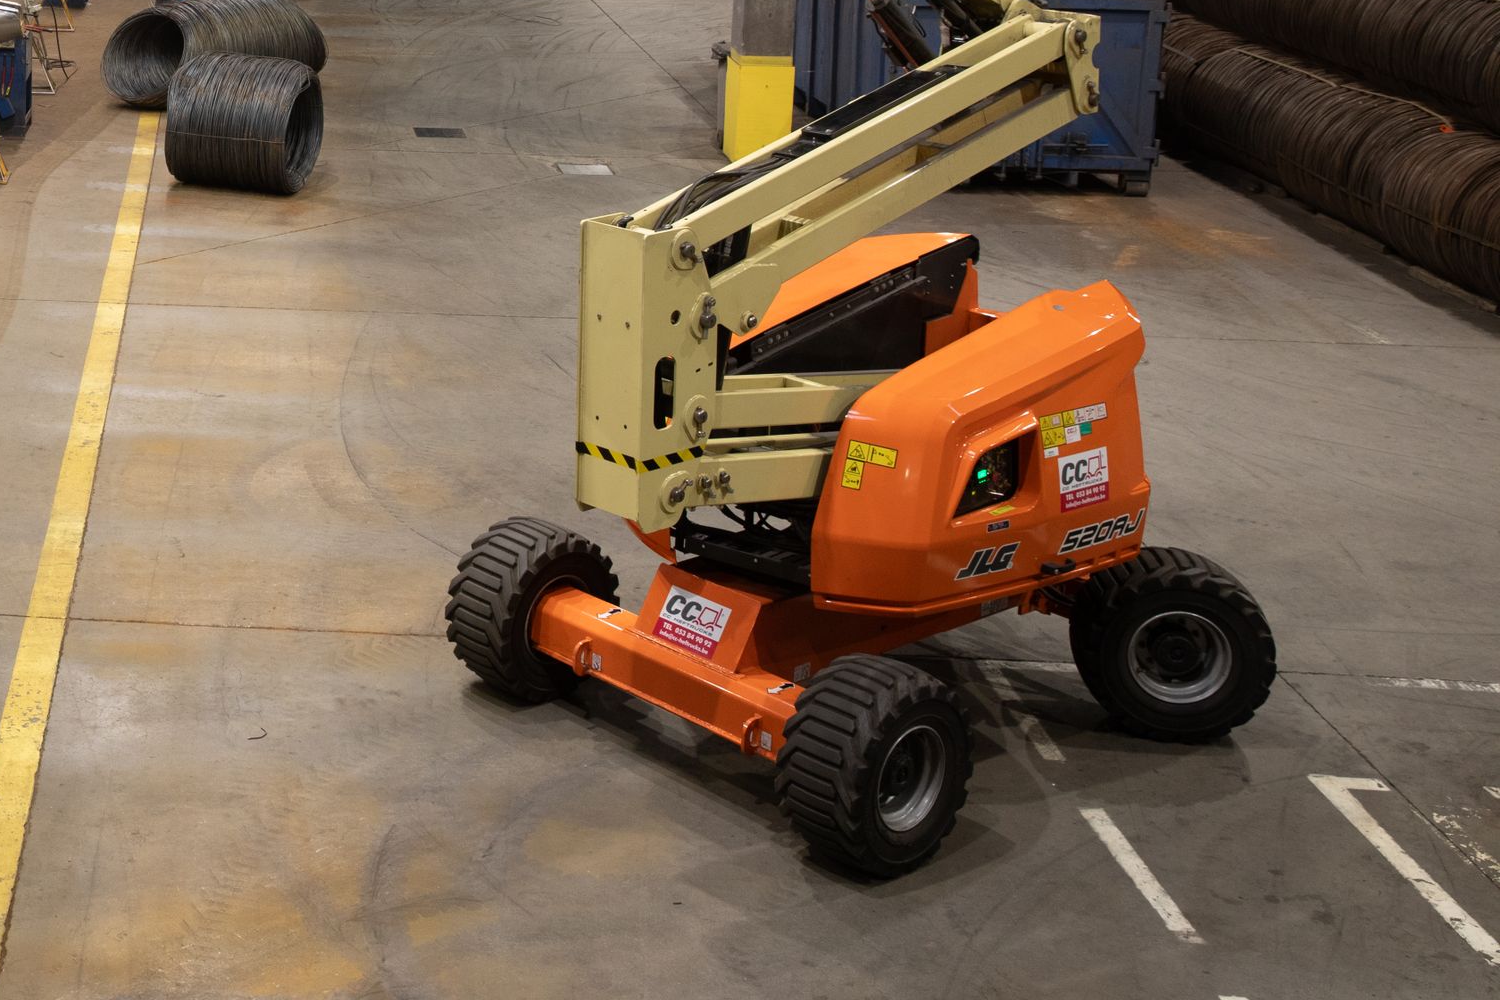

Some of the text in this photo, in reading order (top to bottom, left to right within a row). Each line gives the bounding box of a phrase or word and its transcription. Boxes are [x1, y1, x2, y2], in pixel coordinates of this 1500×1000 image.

[1061, 459, 1088, 485] CC
[1057, 507, 1146, 556] 520AJ
[954, 541, 1021, 581] JLG
[666, 595, 702, 622] CC
[663, 621, 712, 648] TEL 053 84 90 92
